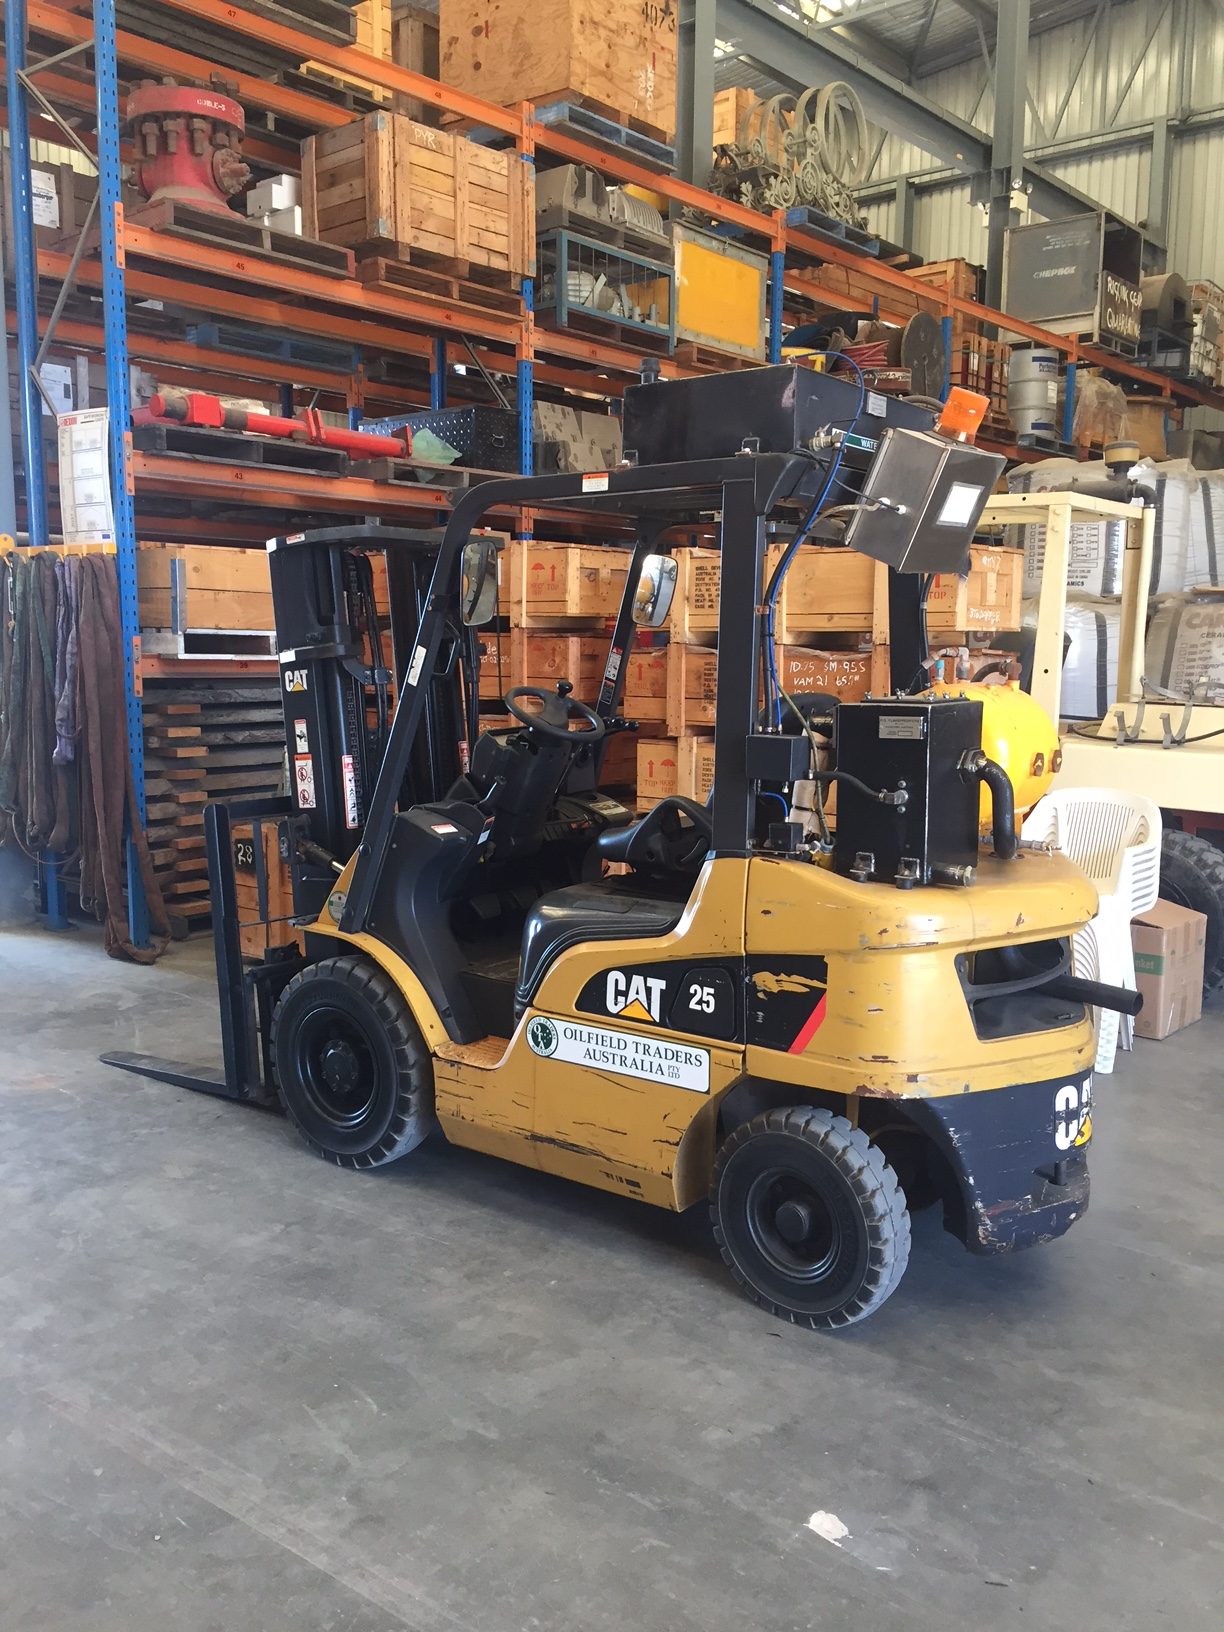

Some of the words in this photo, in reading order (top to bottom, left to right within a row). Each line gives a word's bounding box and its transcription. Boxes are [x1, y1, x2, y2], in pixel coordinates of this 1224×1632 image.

[414, 127, 437, 150] PYR
[860, 438, 878, 450] WATE
[928, 591, 947, 600] TOP
[284, 669, 308, 692] CAT
[793, 676, 814, 686] VAM
[816, 674, 828, 686] 21
[237, 843, 253, 865] 28
[605, 970, 667, 1023] CAT
[688, 983, 716, 1014] 25
[563, 1027, 628, 1051] OILFIELD
[632, 1040, 703, 1068] TRADERS
[583, 1046, 665, 1076] AUSTRALIA
[667, 1064, 681, 1073] PTY
[667, 1071, 681, 1079] LTD
